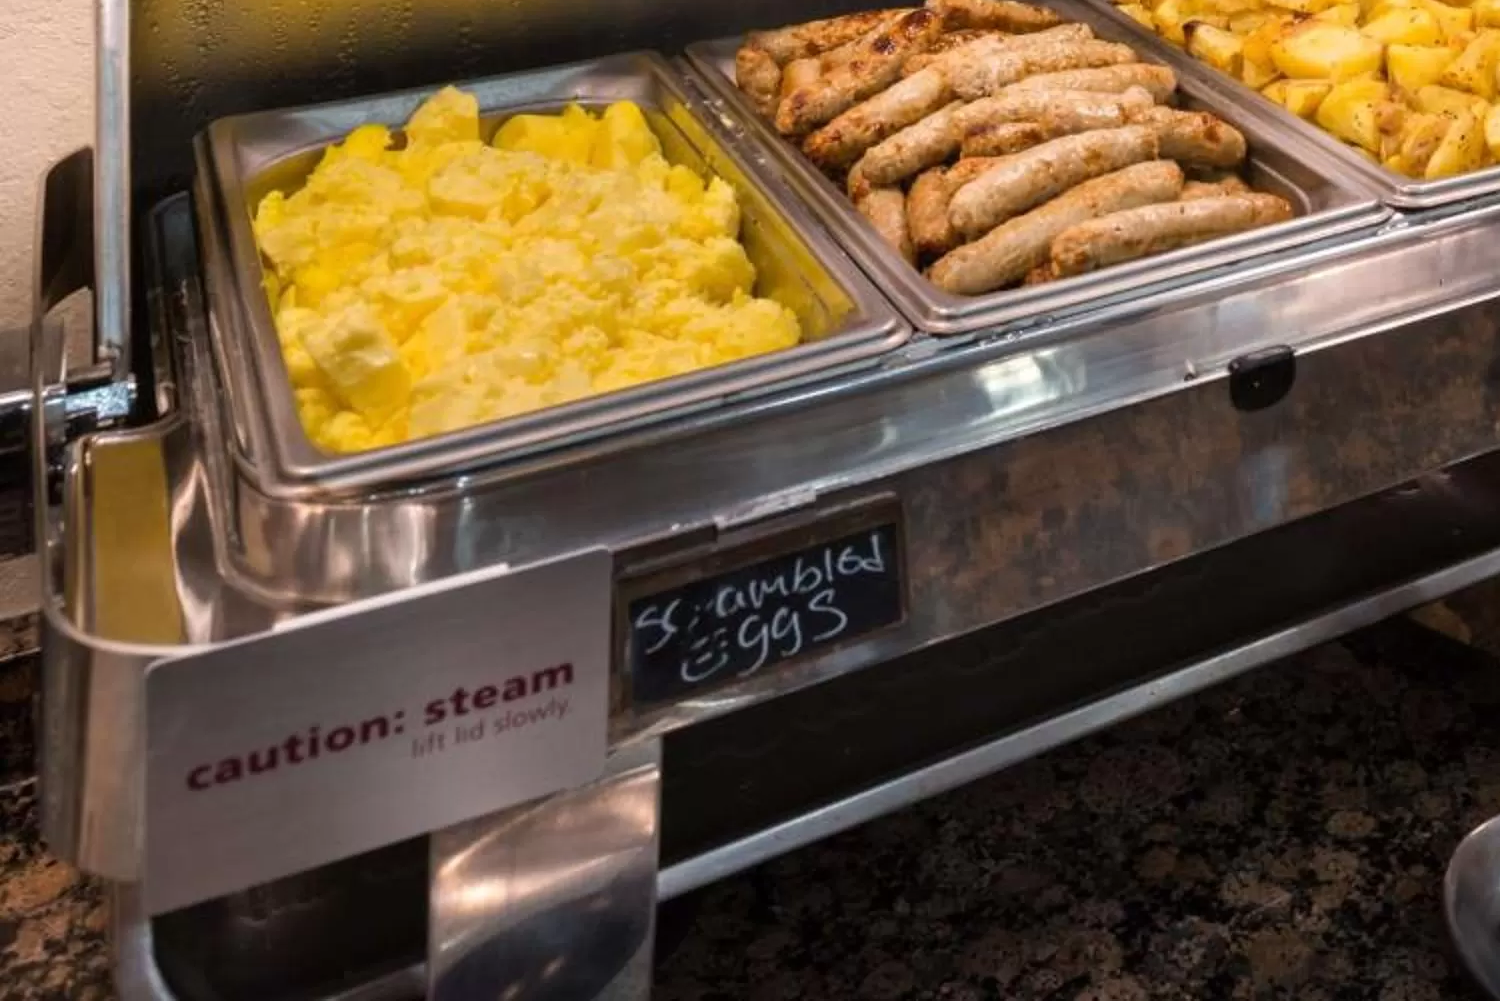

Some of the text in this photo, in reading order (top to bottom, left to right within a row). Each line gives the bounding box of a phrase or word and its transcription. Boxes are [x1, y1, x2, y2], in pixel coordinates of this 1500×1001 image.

[185, 659, 575, 792] caution: steam
[411, 694, 572, 760] lift lid slowly.
